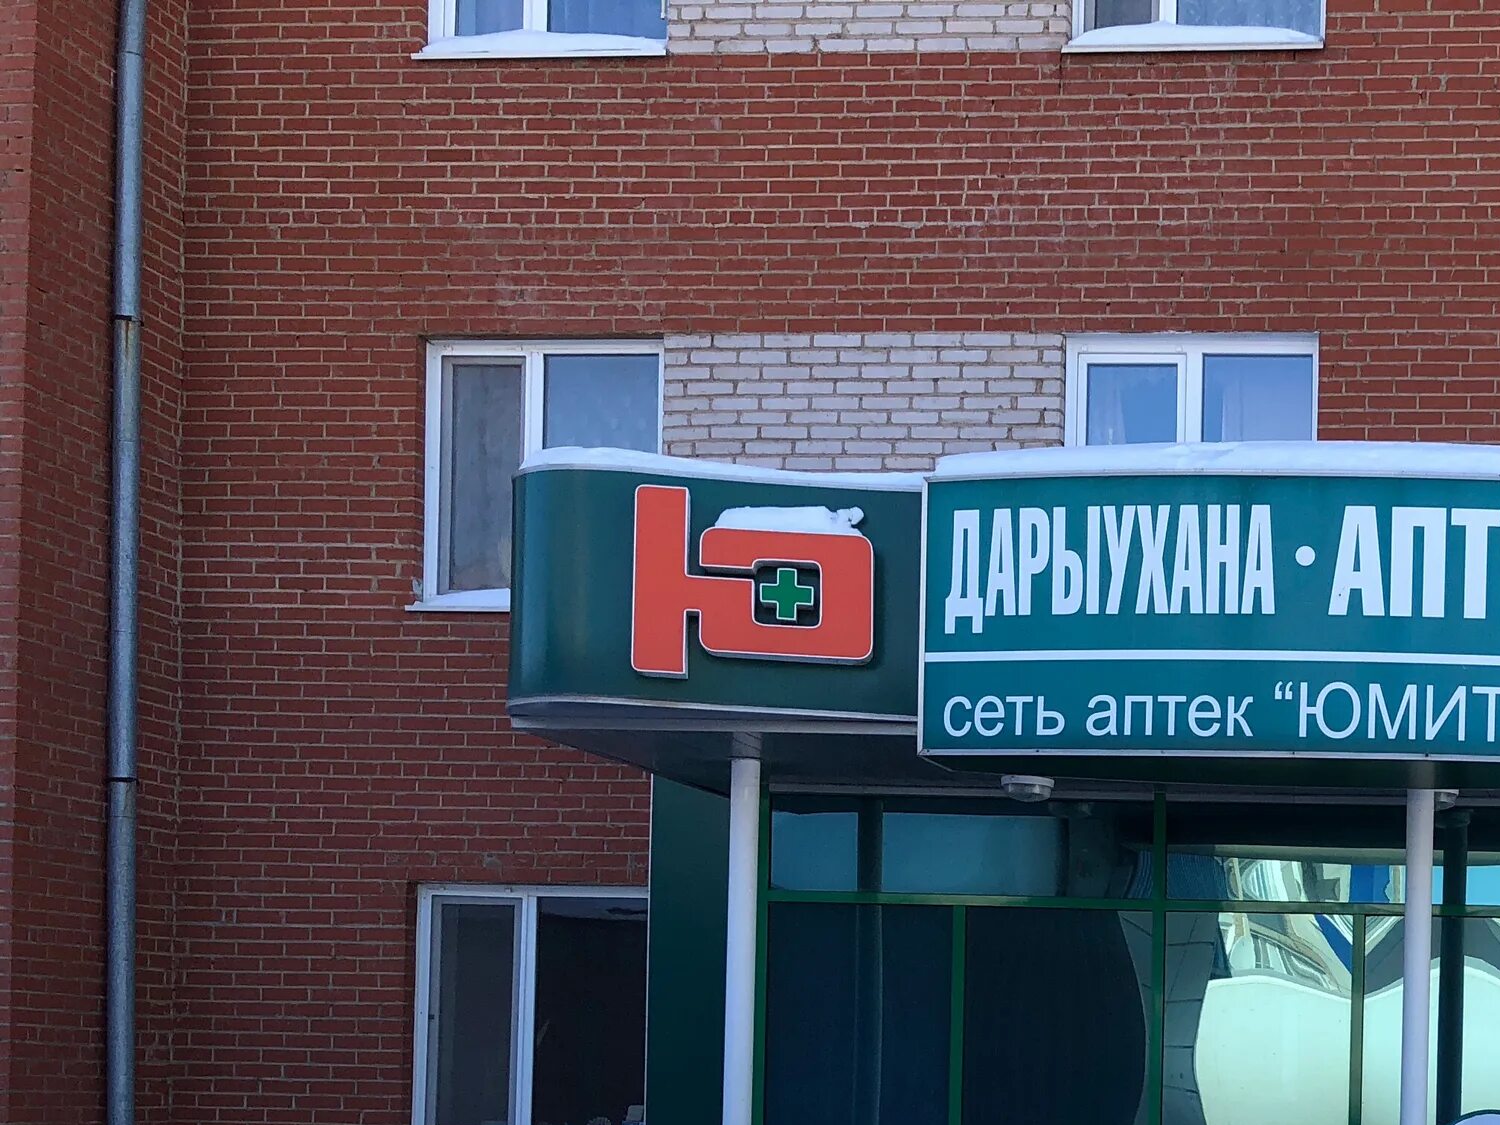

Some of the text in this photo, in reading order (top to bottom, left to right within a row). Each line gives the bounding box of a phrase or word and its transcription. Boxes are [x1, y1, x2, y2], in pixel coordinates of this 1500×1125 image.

[945, 505, 1275, 634] ДАРЫУХАНА
[944, 695, 1065, 737] сеть
[1086, 695, 1254, 738] аптек
